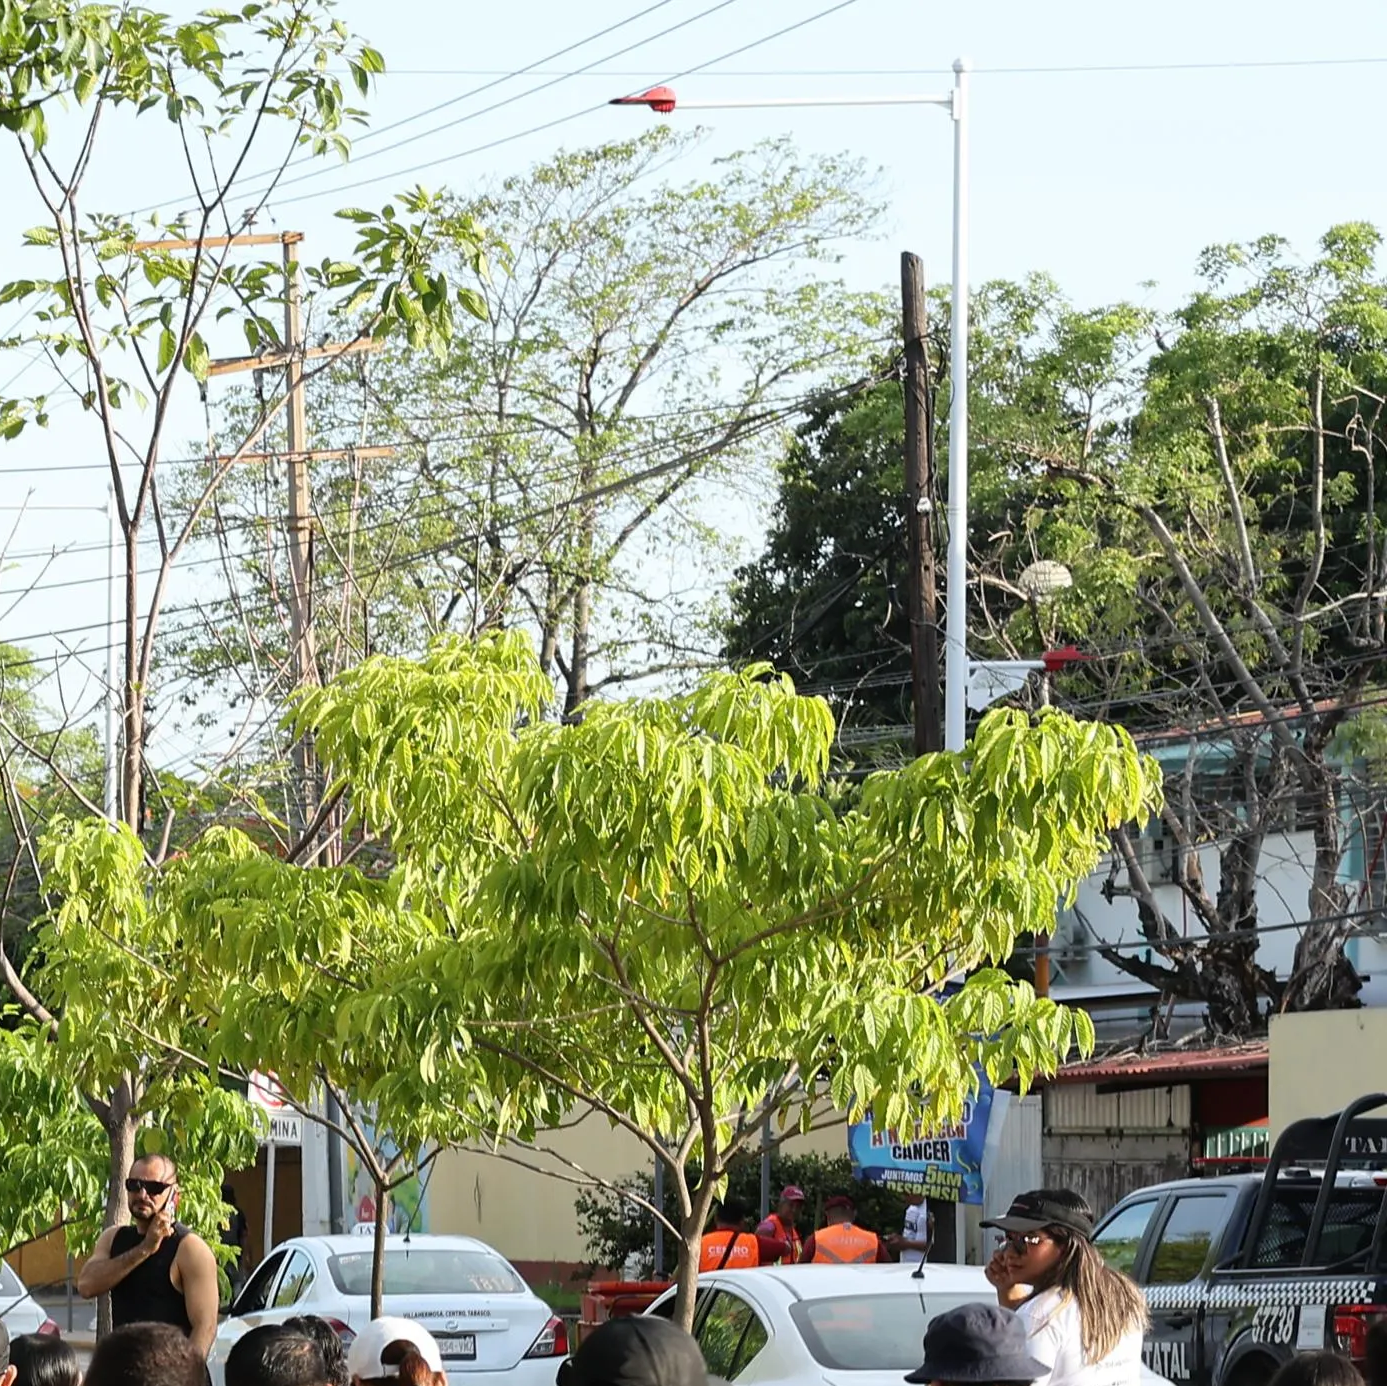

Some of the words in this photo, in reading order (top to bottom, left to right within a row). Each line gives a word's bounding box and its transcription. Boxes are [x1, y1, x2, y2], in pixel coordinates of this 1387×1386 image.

[892, 1141, 951, 1162] CANCER
[881, 1169, 924, 1183] JUNTEMOS
[926, 1164, 962, 1187] 5KM
